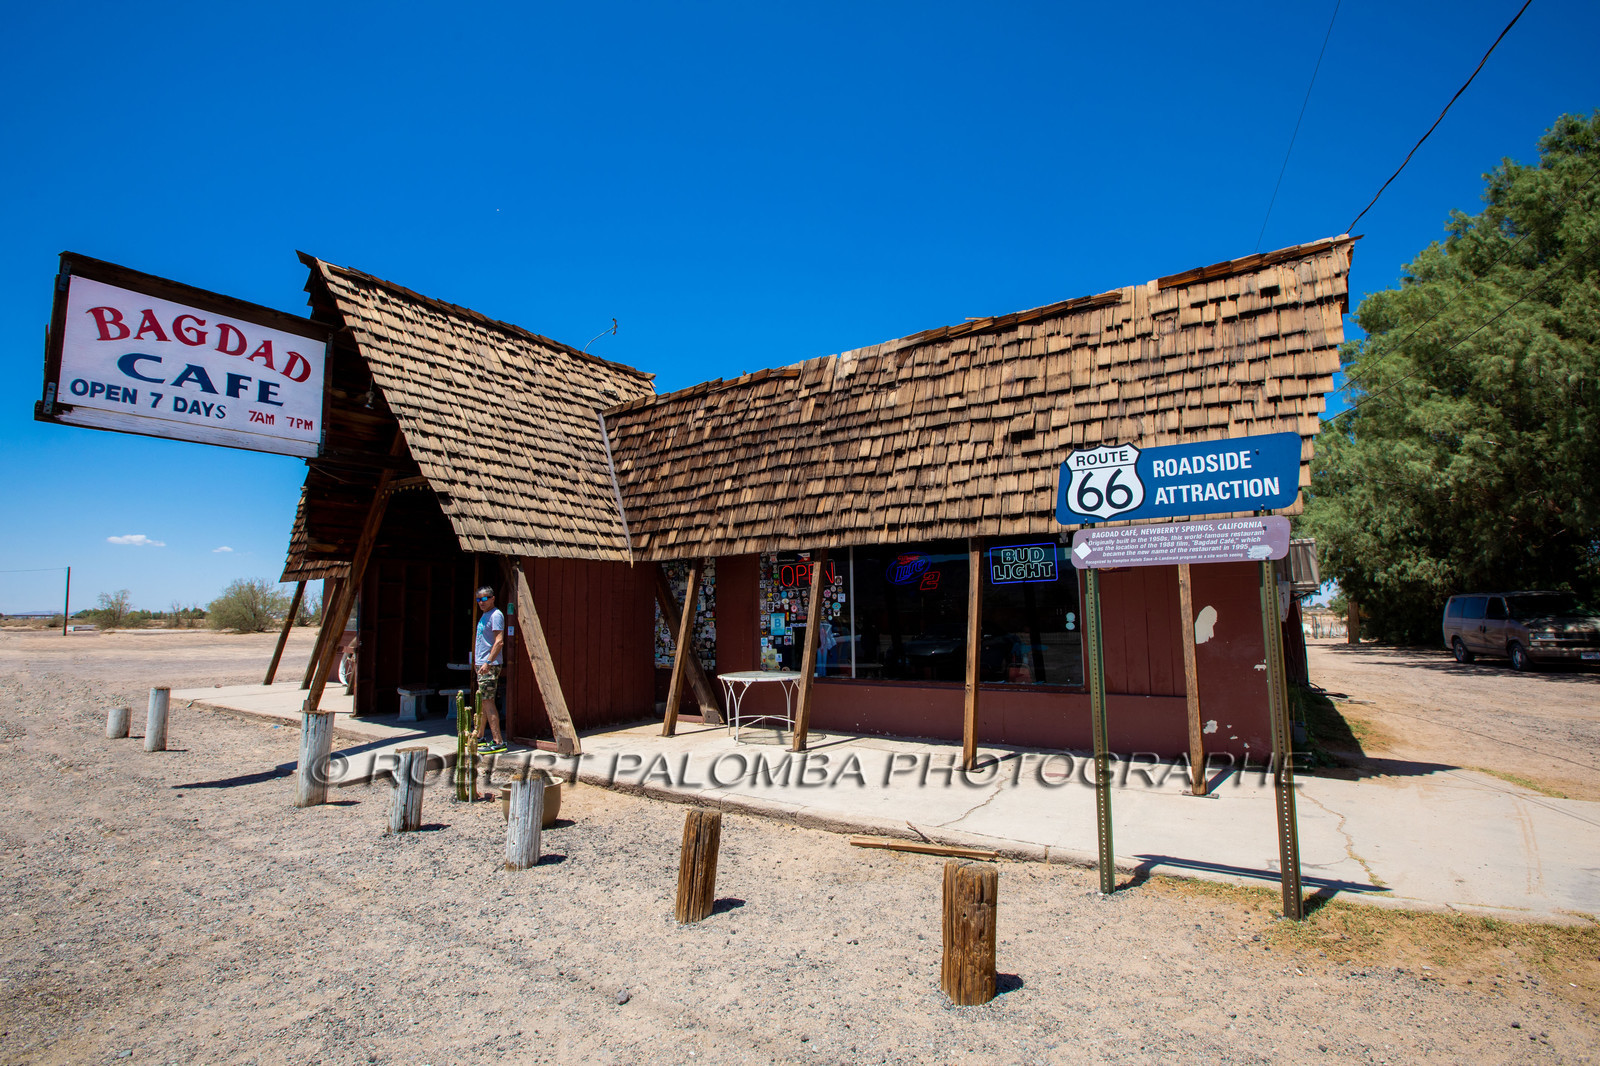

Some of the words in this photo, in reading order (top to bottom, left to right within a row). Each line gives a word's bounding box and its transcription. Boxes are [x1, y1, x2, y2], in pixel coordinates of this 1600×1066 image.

[86, 306, 312, 383] BAGDAD
[117, 352, 285, 407] CAFE
[70, 378, 138, 405] OPEN
[150, 392, 164, 409] 7
[173, 396, 227, 420] DAYS
[248, 410, 275, 426] 7AM
[286, 416, 313, 431] 7PM
[1075, 450, 1129, 467] ROUTE
[1152, 450, 1252, 478] ROADSIDE
[1077, 468, 1133, 512] 66
[1154, 476, 1280, 505] ATTRACTION
[1088, 539, 1115, 547] Originally
[1184, 532, 1229, 540] world-famous
[1230, 529, 1265, 537] restaurant
[1091, 530, 1119, 539] BAGDAD
[1120, 528, 1138, 537] CAFÉ,
[1140, 526, 1180, 535] NEWBERRY
[1181, 524, 1215, 533] SPRINGS,
[1217, 520, 1263, 530] CALIFORNIA
[1001, 547, 1045, 564] BUD
[1188, 545, 1221, 553] restaurant
[920, 570, 940, 590] 2
[993, 561, 1054, 580] LIGHT
[774, 618, 781, 628] B
